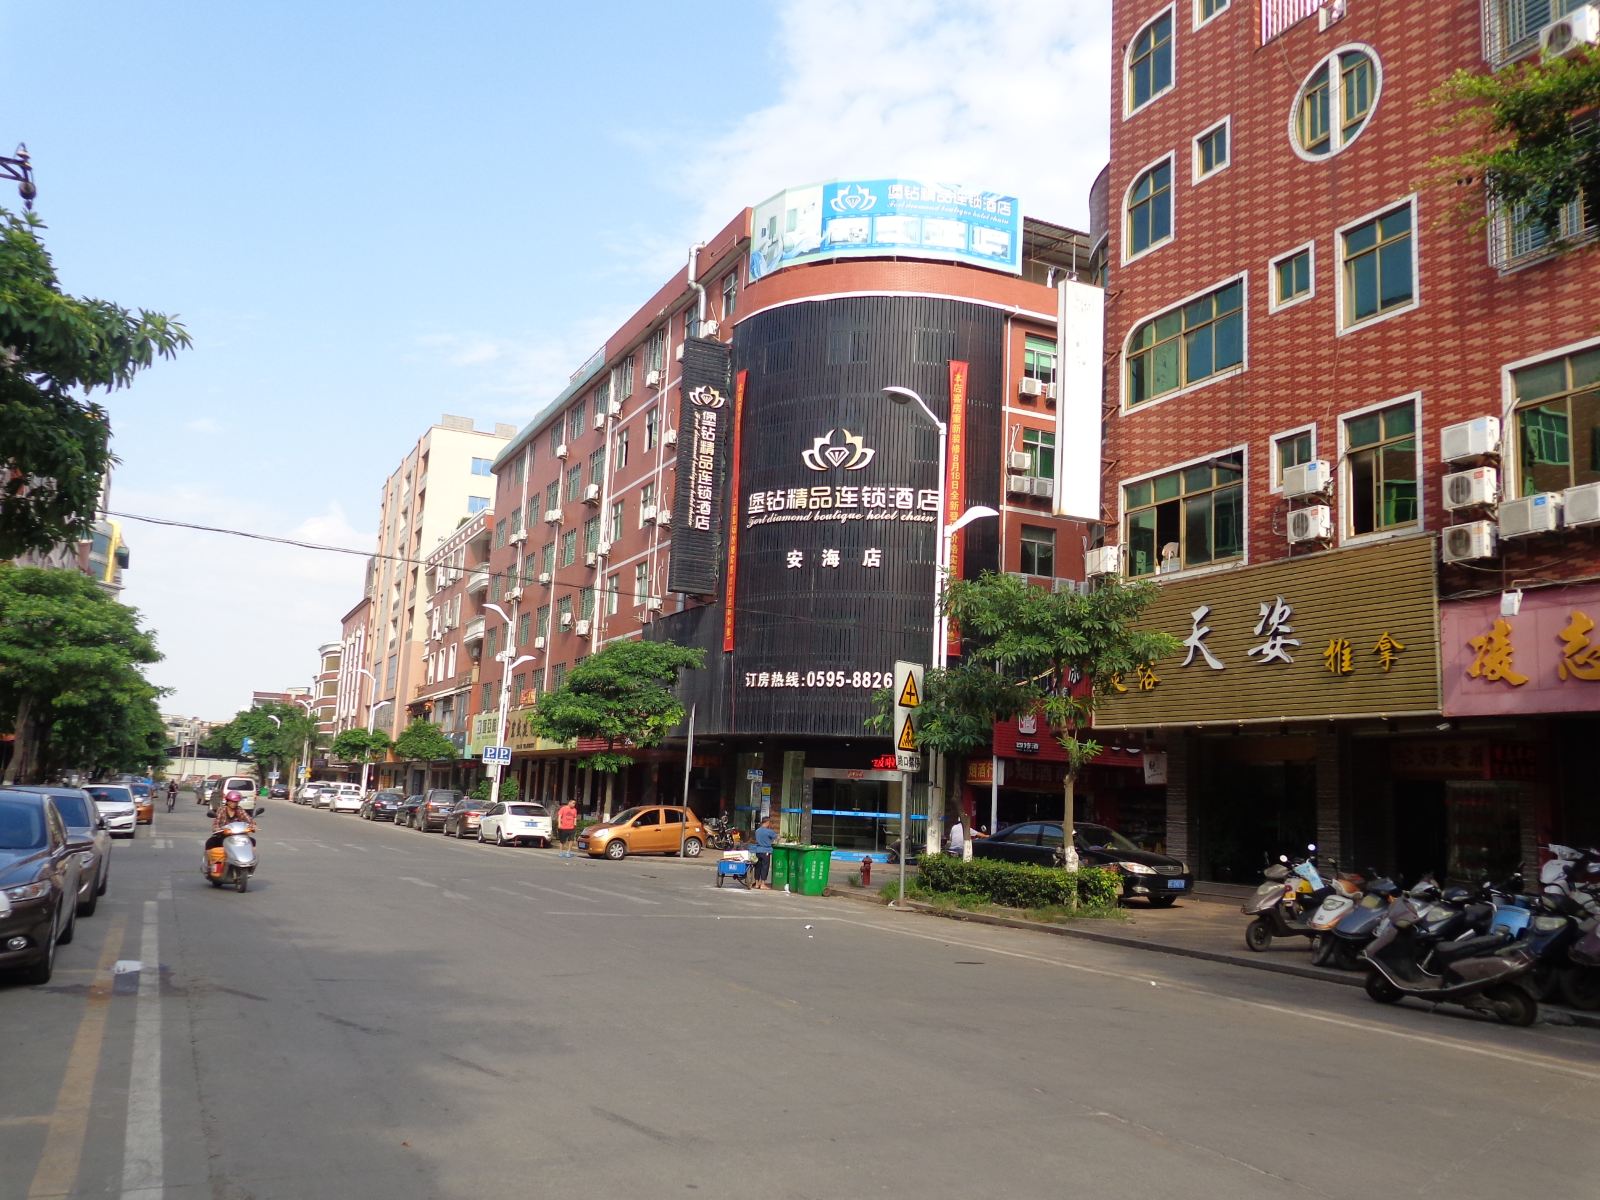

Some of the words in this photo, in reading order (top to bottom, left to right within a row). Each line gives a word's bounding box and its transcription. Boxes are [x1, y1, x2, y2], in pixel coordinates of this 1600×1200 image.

[694, 410, 717, 531] 堡钻精品连锁酒店
[748, 486, 939, 514] 堡钻精品连锁酒店
[767, 511, 813, 523] diamond
[813, 509, 864, 524] boutique
[866, 509, 898, 521] hotel
[900, 510, 936, 523] chain
[1322, 631, 1406, 677] 推拿
